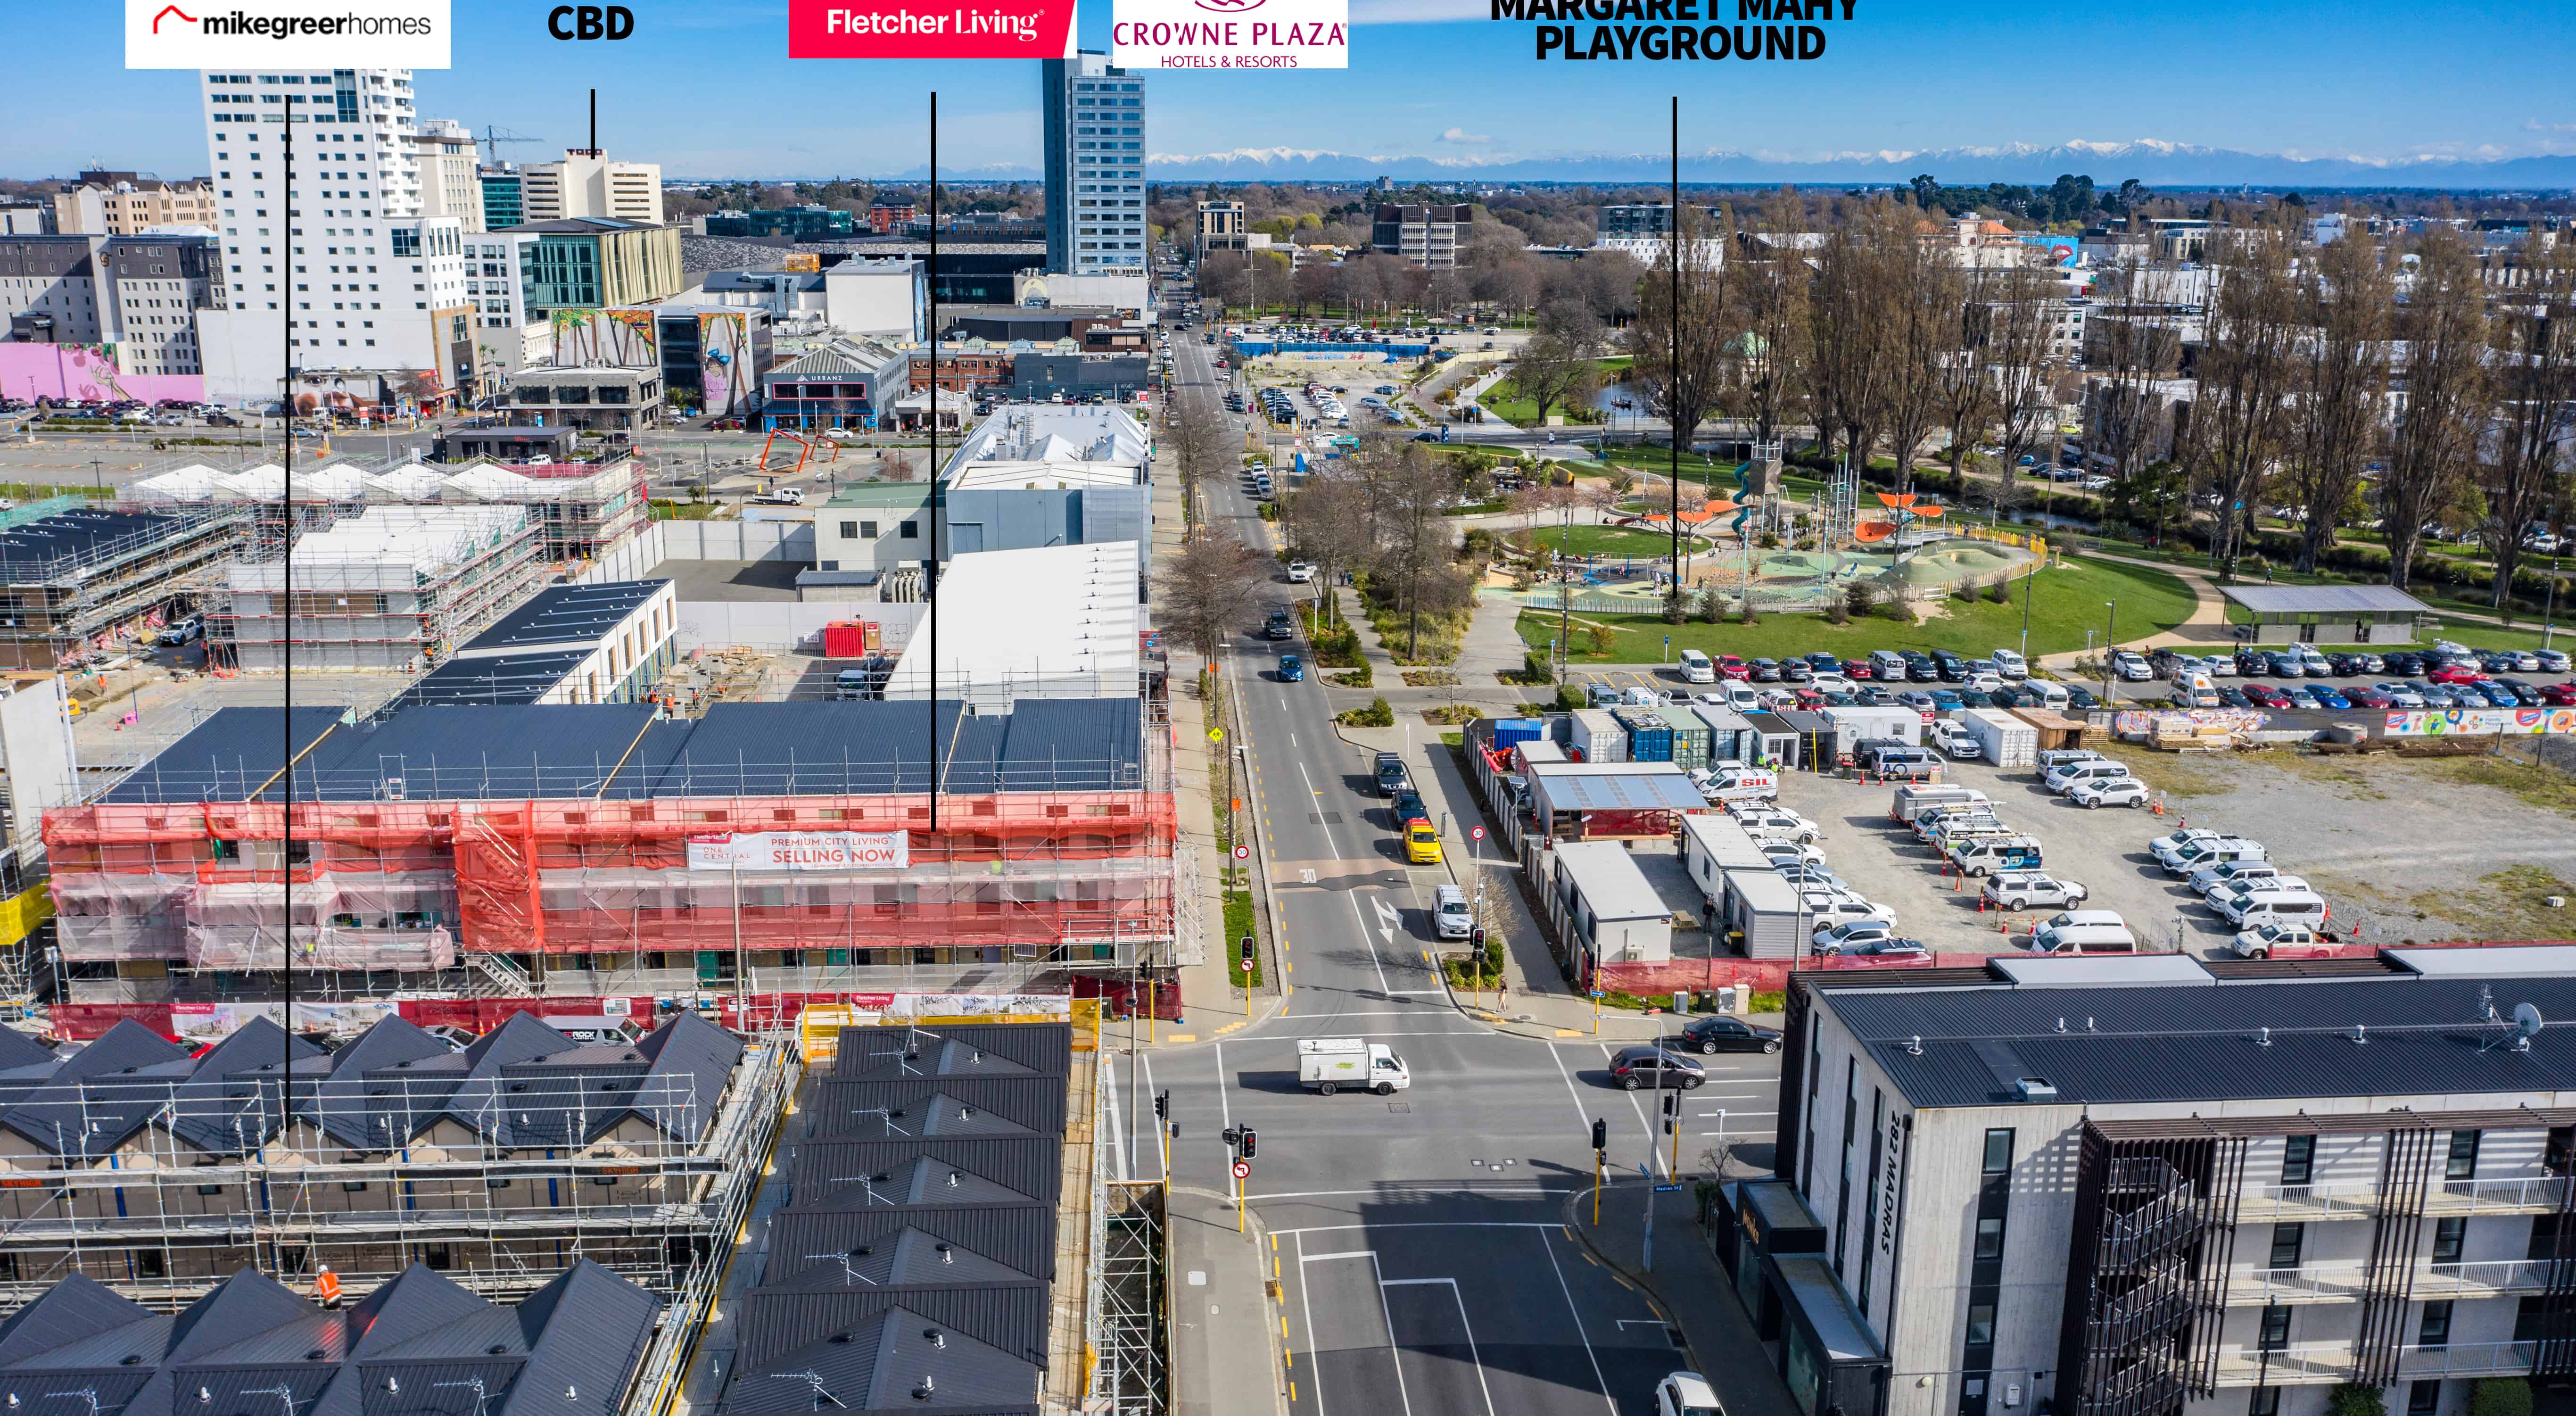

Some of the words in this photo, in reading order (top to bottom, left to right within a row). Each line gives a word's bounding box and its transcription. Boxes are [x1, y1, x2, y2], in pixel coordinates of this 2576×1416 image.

[771, 838, 820, 846] PREMIUM
[825, 837, 848, 845] CITY
[852, 837, 889, 845] LIVING
[773, 849, 844, 863] SELLING
[852, 849, 895, 862] NOW
[1890, 1110, 1900, 1154] 282
[1, 1179, 41, 1187] SKYHIGH
[1881, 1155, 1897, 1255] MADRAS
